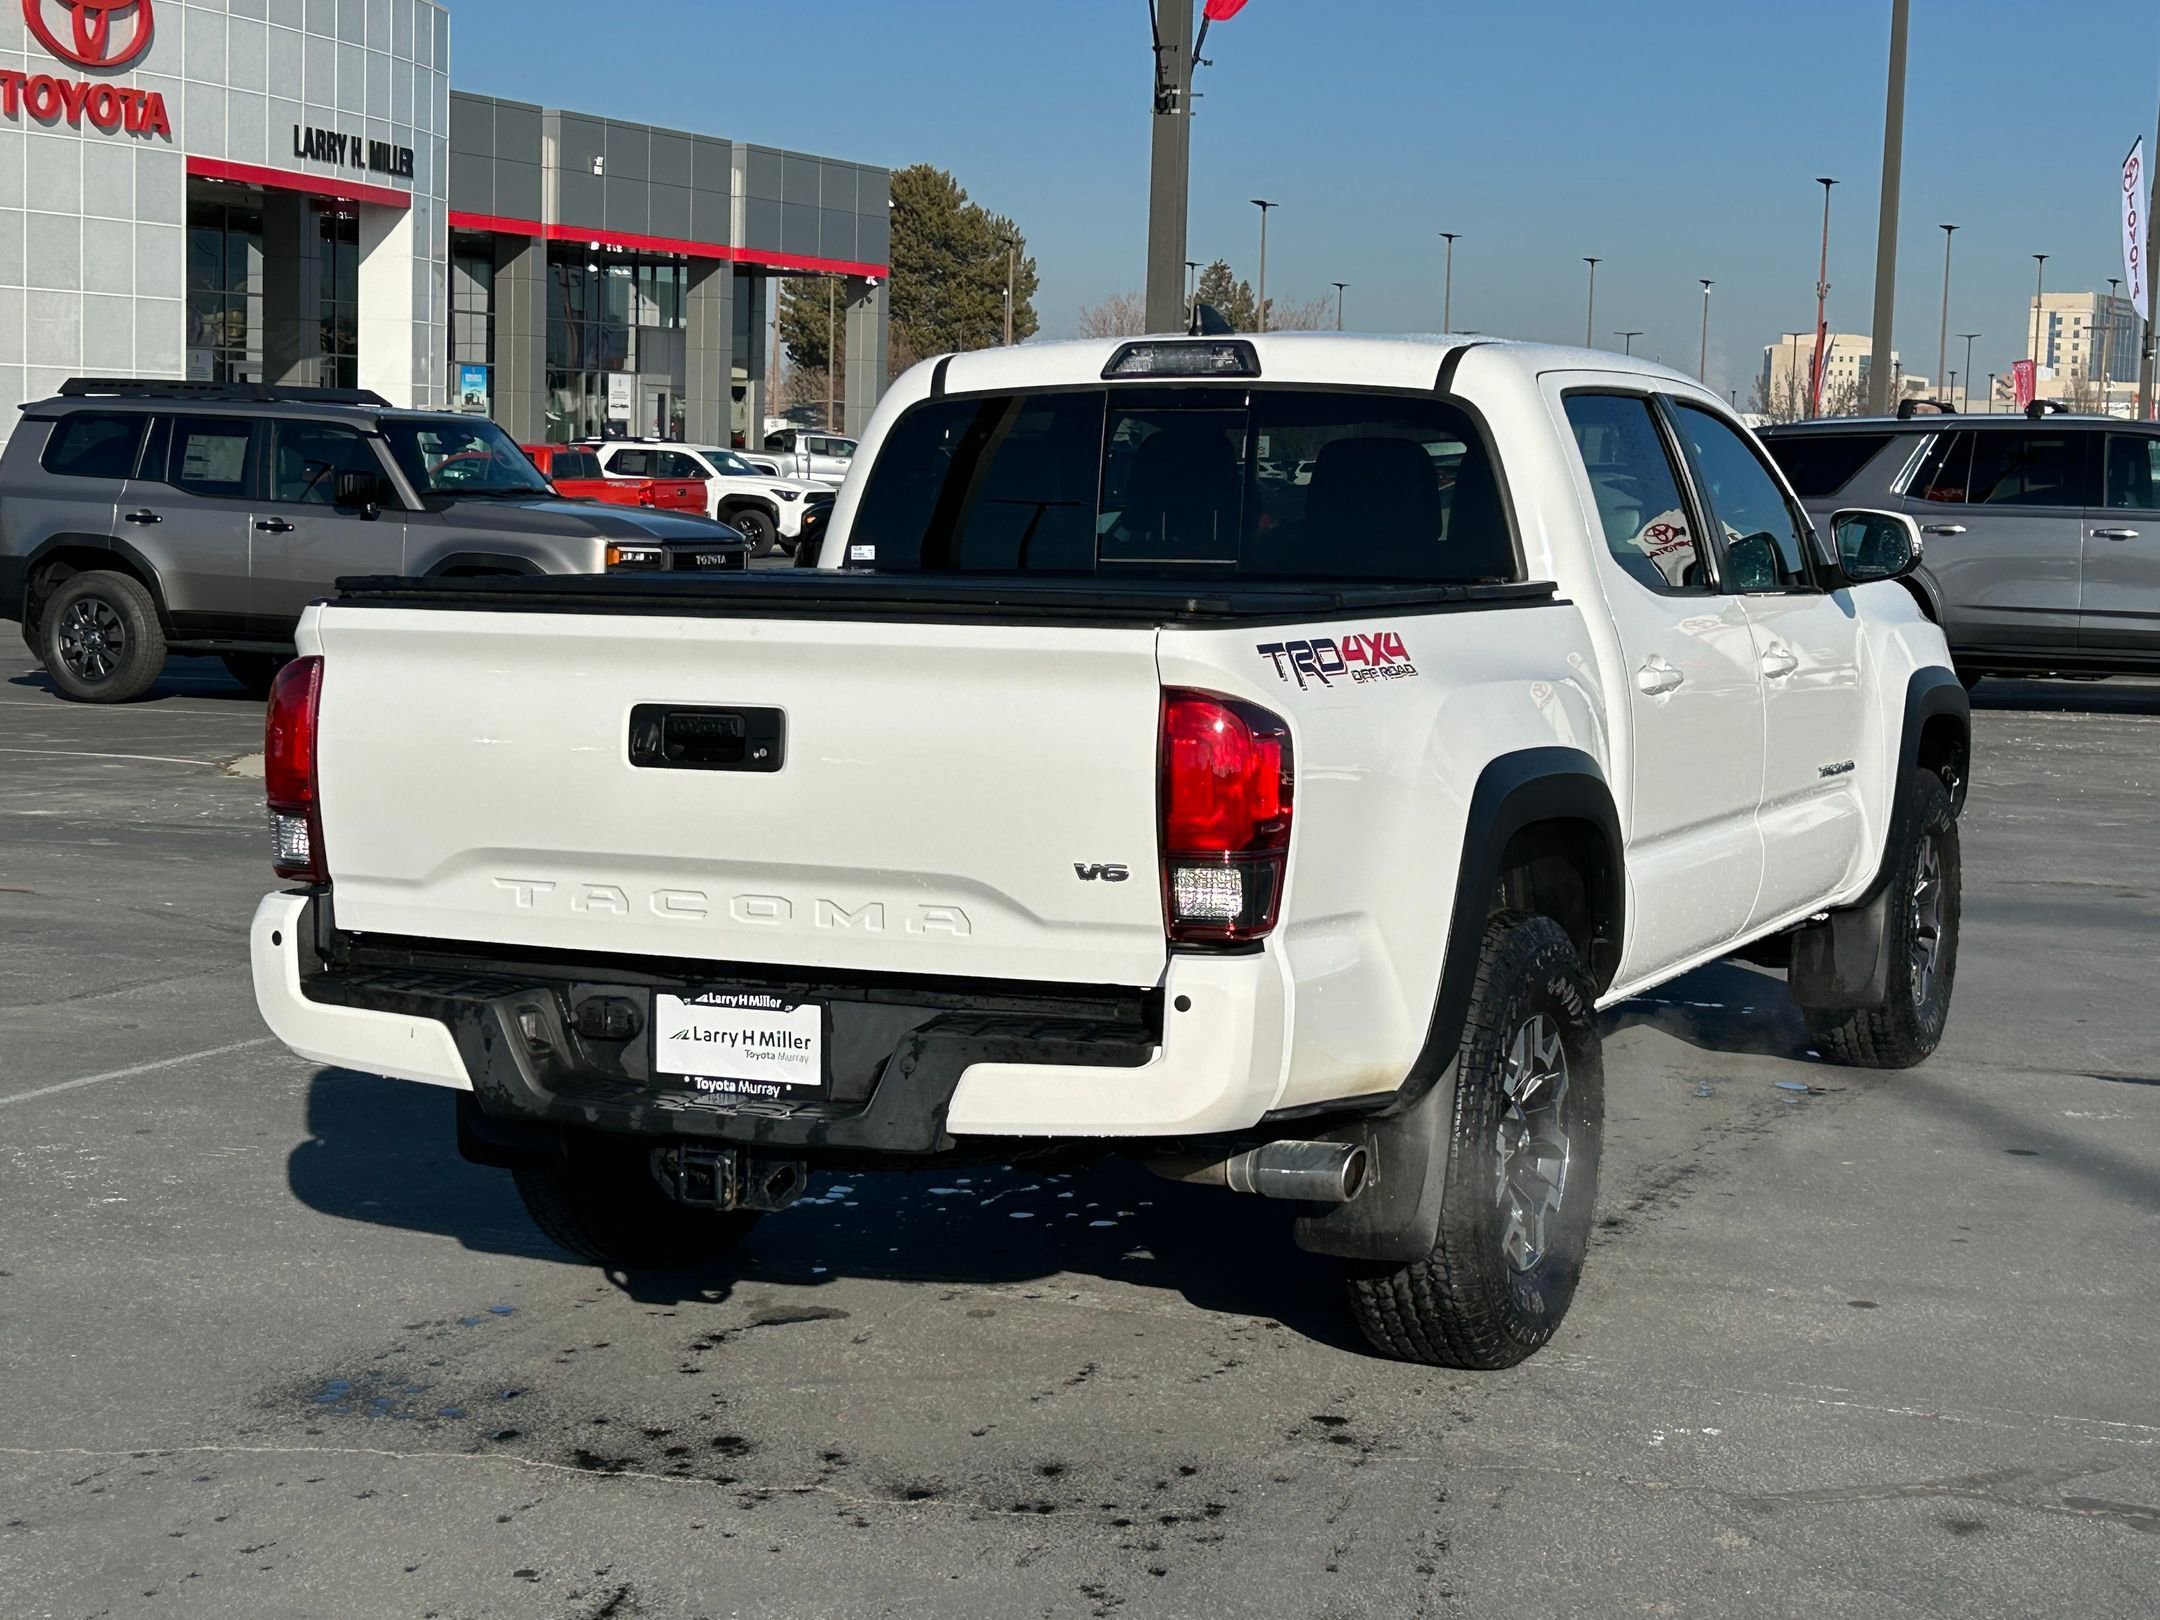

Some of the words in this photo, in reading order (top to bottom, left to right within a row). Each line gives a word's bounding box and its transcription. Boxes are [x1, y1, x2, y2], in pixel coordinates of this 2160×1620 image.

[0, 70, 172, 139] TOYOTA
[294, 124, 347, 167] LARRY
[351, 136, 365, 169] H.
[369, 140, 413, 178] MILLER
[2127, 192, 2141, 299] TOYOTA
[1256, 638, 1348, 690] TRD
[1341, 632, 1411, 666] 4X4
[1351, 668, 1379, 684] OFF
[1380, 664, 1418, 681] ROAD
[1073, 863, 1130, 882] V6
[493, 877, 972, 936] TACOMA
[708, 992, 736, 1007] Larry
[738, 994, 748, 1006] H
[749, 994, 782, 1009] Miller
[693, 1026, 739, 1047] Larry
[743, 1030, 755, 1046] H
[759, 1031, 811, 1050] Miller
[745, 1049, 776, 1061] Toyota
[777, 1052, 810, 1064] Murray
[694, 1077, 736, 1093] Toyota
[738, 1080, 780, 1098] Murray
